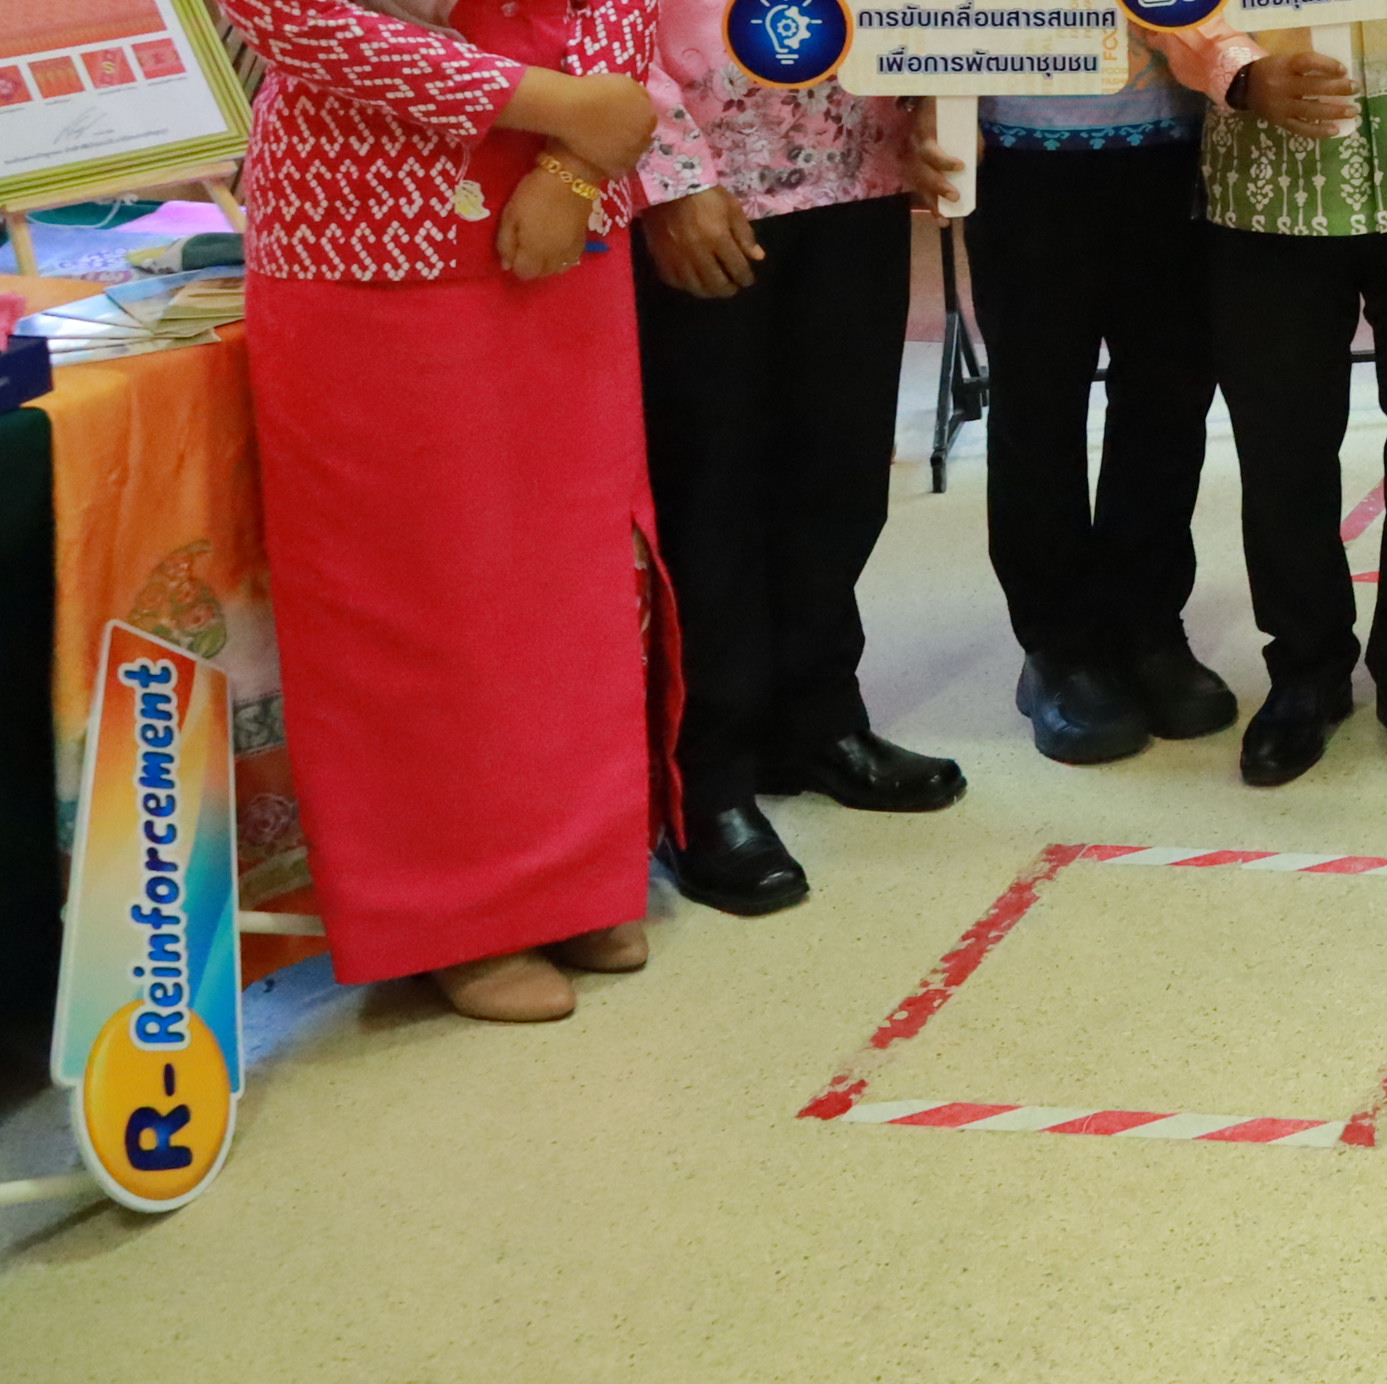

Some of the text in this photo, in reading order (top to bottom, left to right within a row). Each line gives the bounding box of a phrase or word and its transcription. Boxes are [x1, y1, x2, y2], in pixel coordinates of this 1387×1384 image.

[858, 0, 1117, 28] การขับเคลื่อนสารสนเทศ
[879, 46, 1098, 78] เพื่อการพัฒนาชุมชน
[122, 660, 187, 1046] Reinforcement
